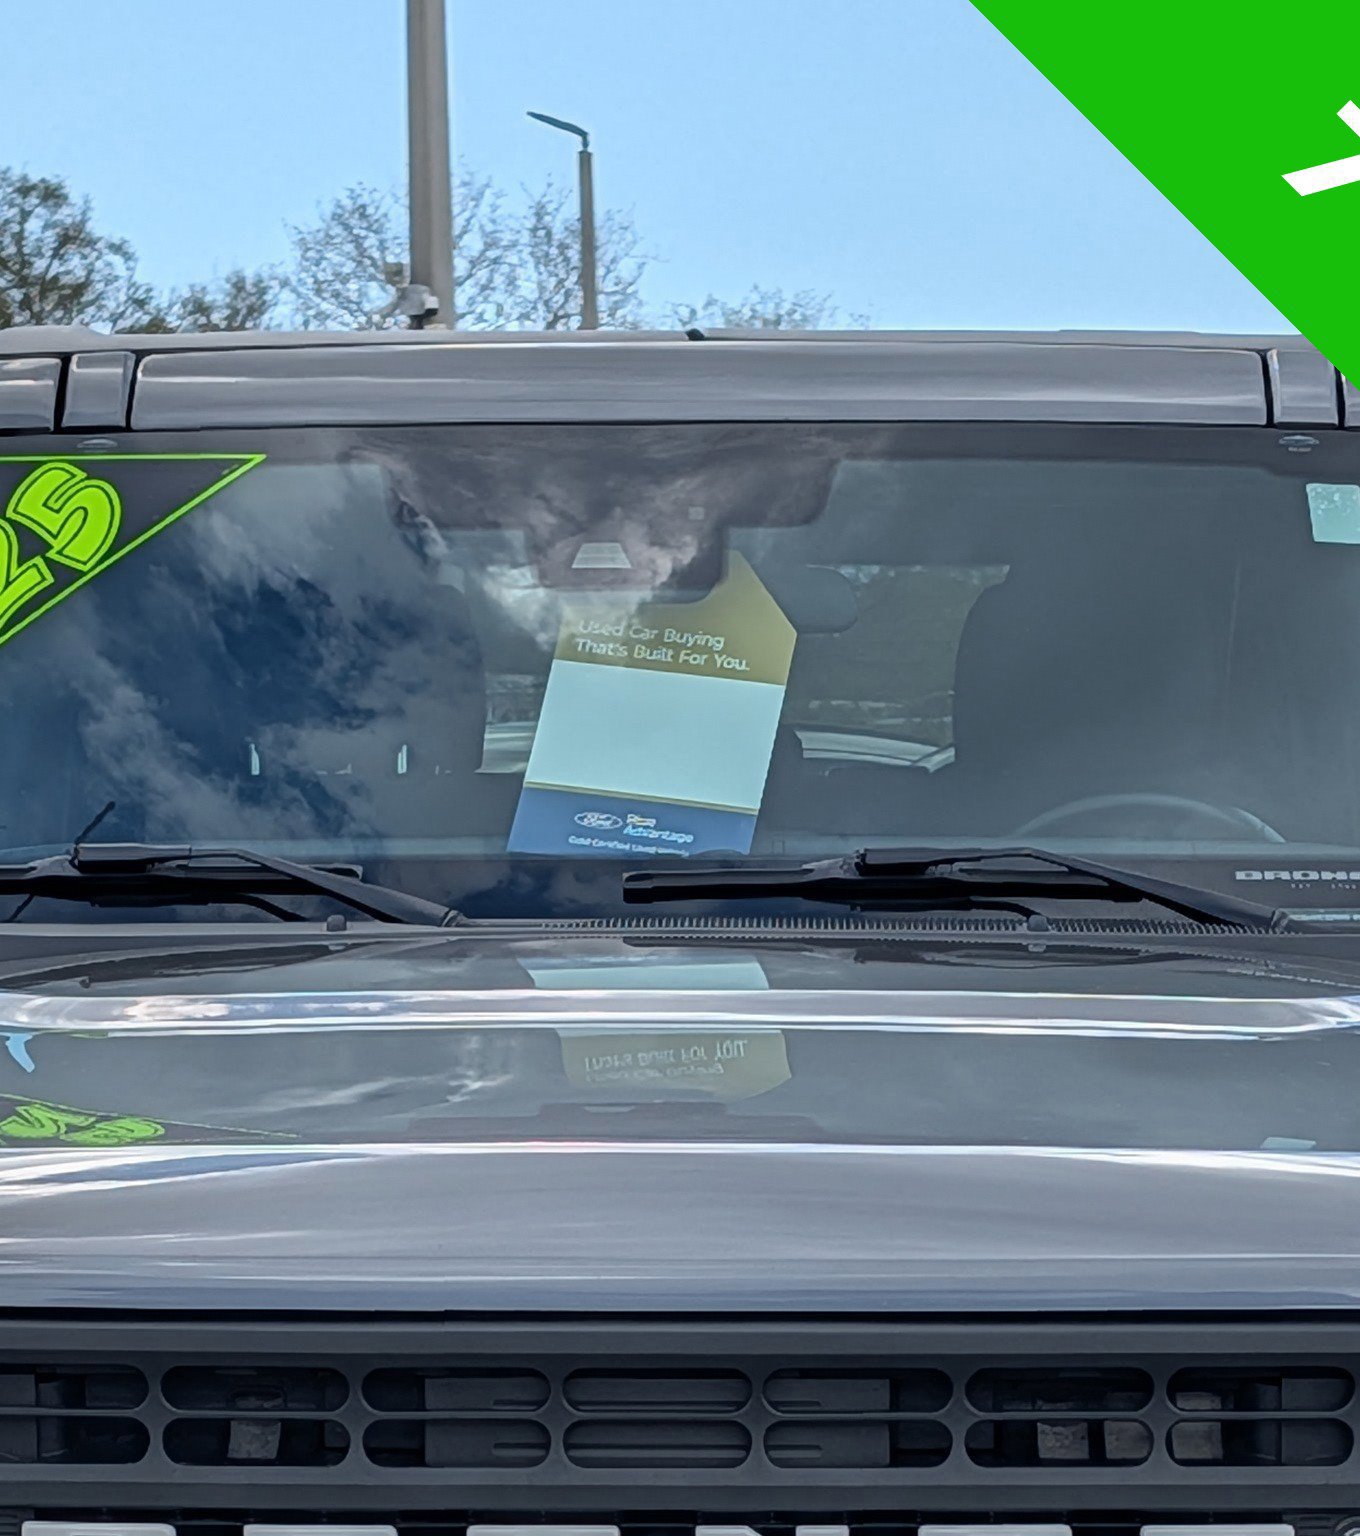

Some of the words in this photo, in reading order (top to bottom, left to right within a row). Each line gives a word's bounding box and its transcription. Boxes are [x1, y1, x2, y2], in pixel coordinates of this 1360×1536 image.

[580, 618, 626, 637] Used
[629, 625, 659, 640] Car
[663, 628, 726, 652] Buying
[575, 638, 629, 657] That's
[678, 649, 709, 666] For
